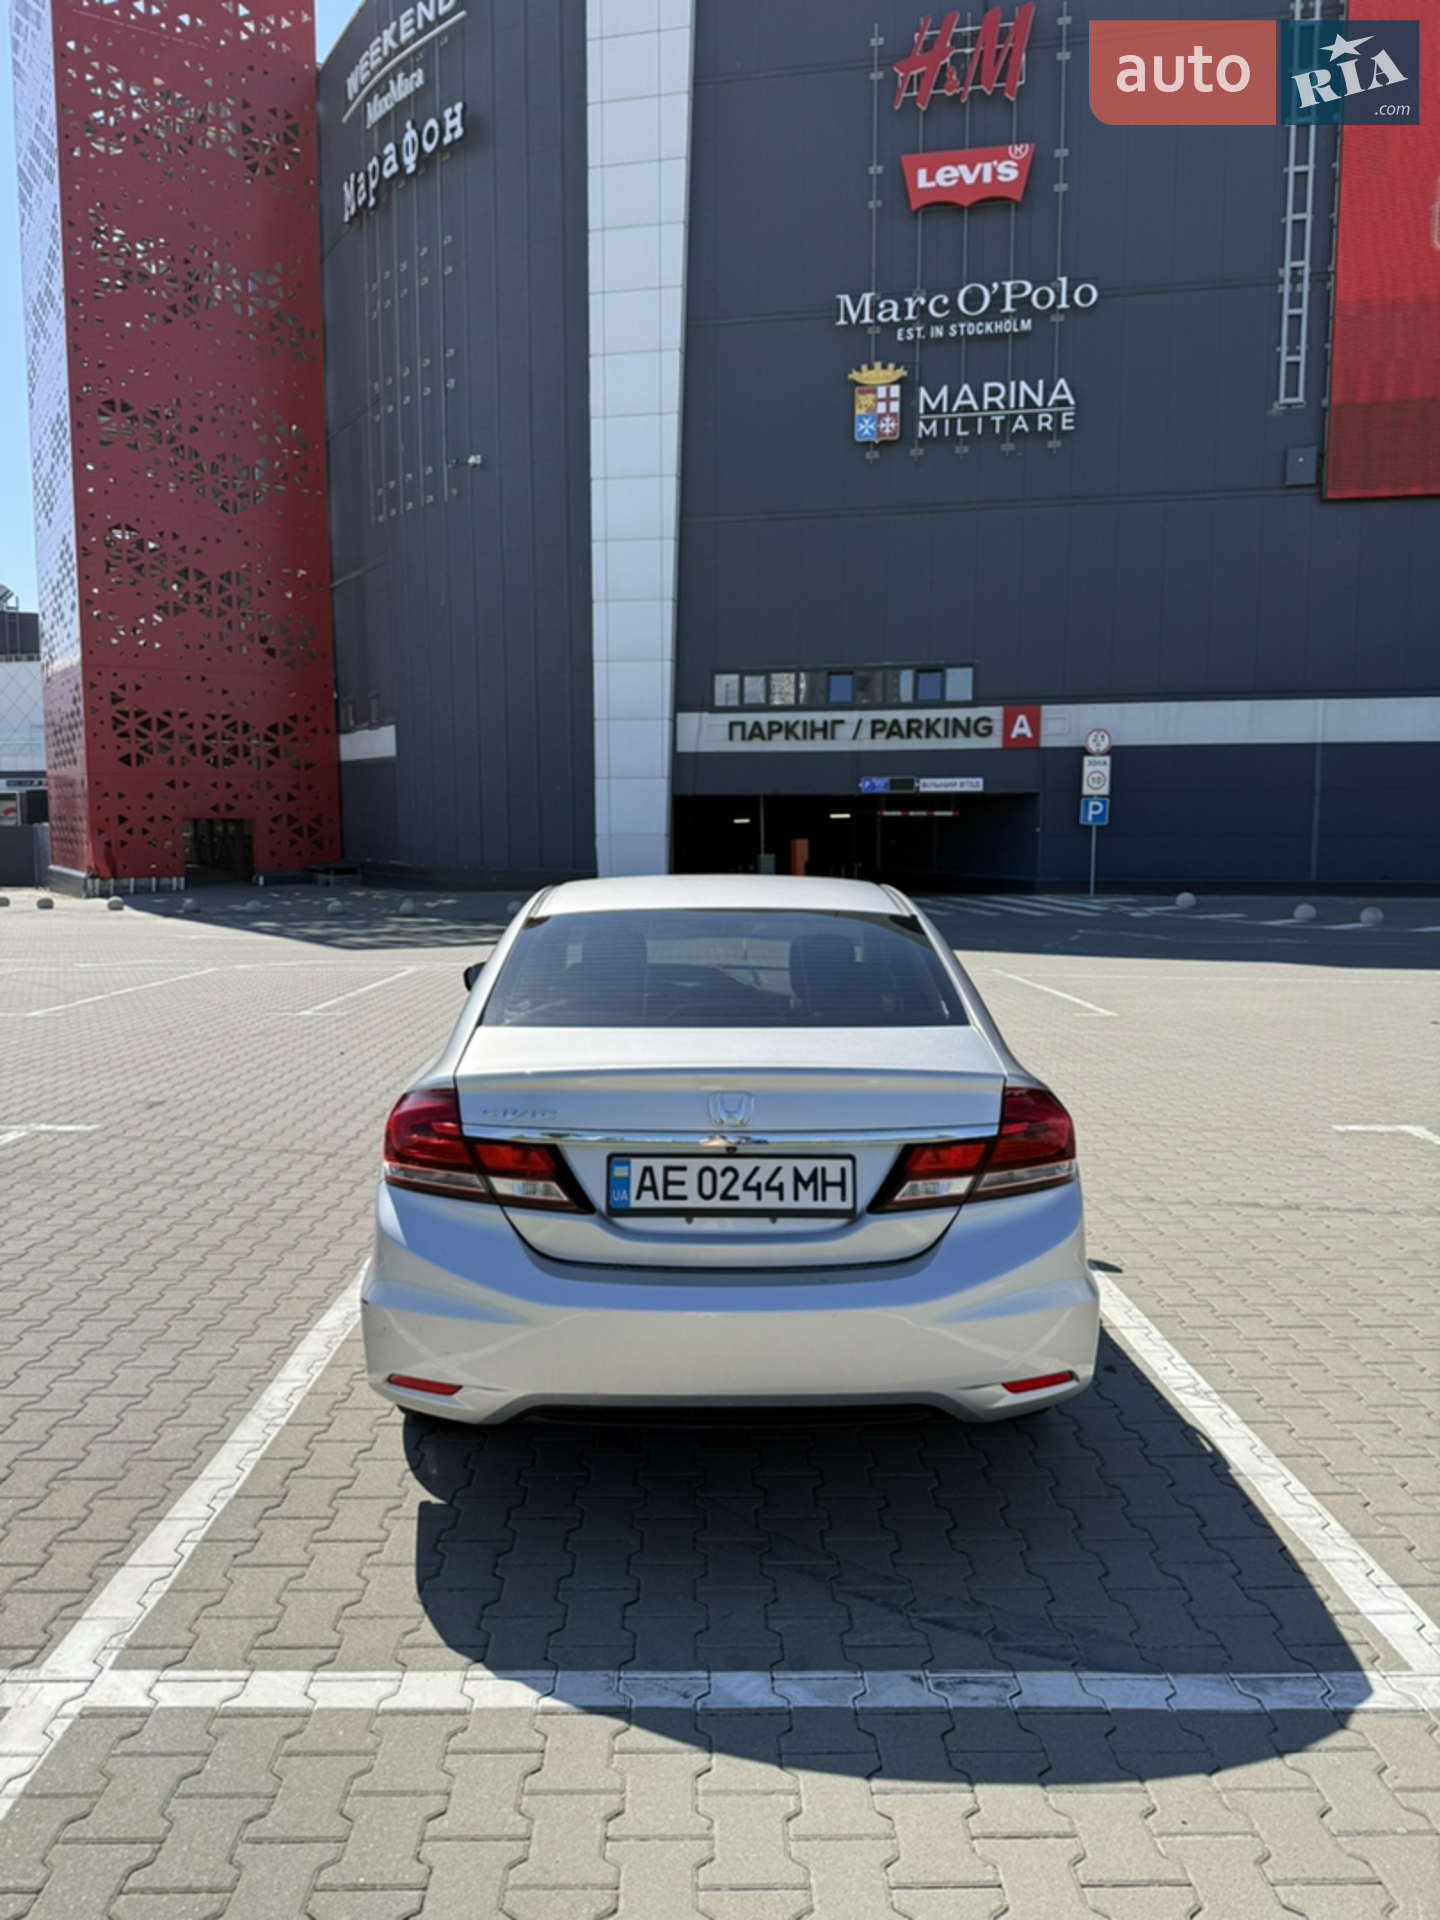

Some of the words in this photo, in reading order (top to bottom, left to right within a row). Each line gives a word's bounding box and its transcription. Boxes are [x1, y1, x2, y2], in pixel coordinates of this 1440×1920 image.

[835, 291, 950, 326] Marc
[957, 276, 1098, 316] O'Polo
[897, 325, 926, 341] EST.
[930, 325, 944, 338] IN
[949, 318, 1032, 337] STOCKHOLM
[918, 377, 1075, 414] MARINA
[918, 411, 1075, 438] MILITARE
[728, 719, 845, 742] ПАРКІНГ
[870, 716, 993, 740] PARKING
[1088, 801, 1103, 822] P
[612, 1190, 629, 1201] UA
[635, 1165, 688, 1201] AE
[697, 1165, 784, 1201] 0244
[793, 1166, 846, 1202] MH
